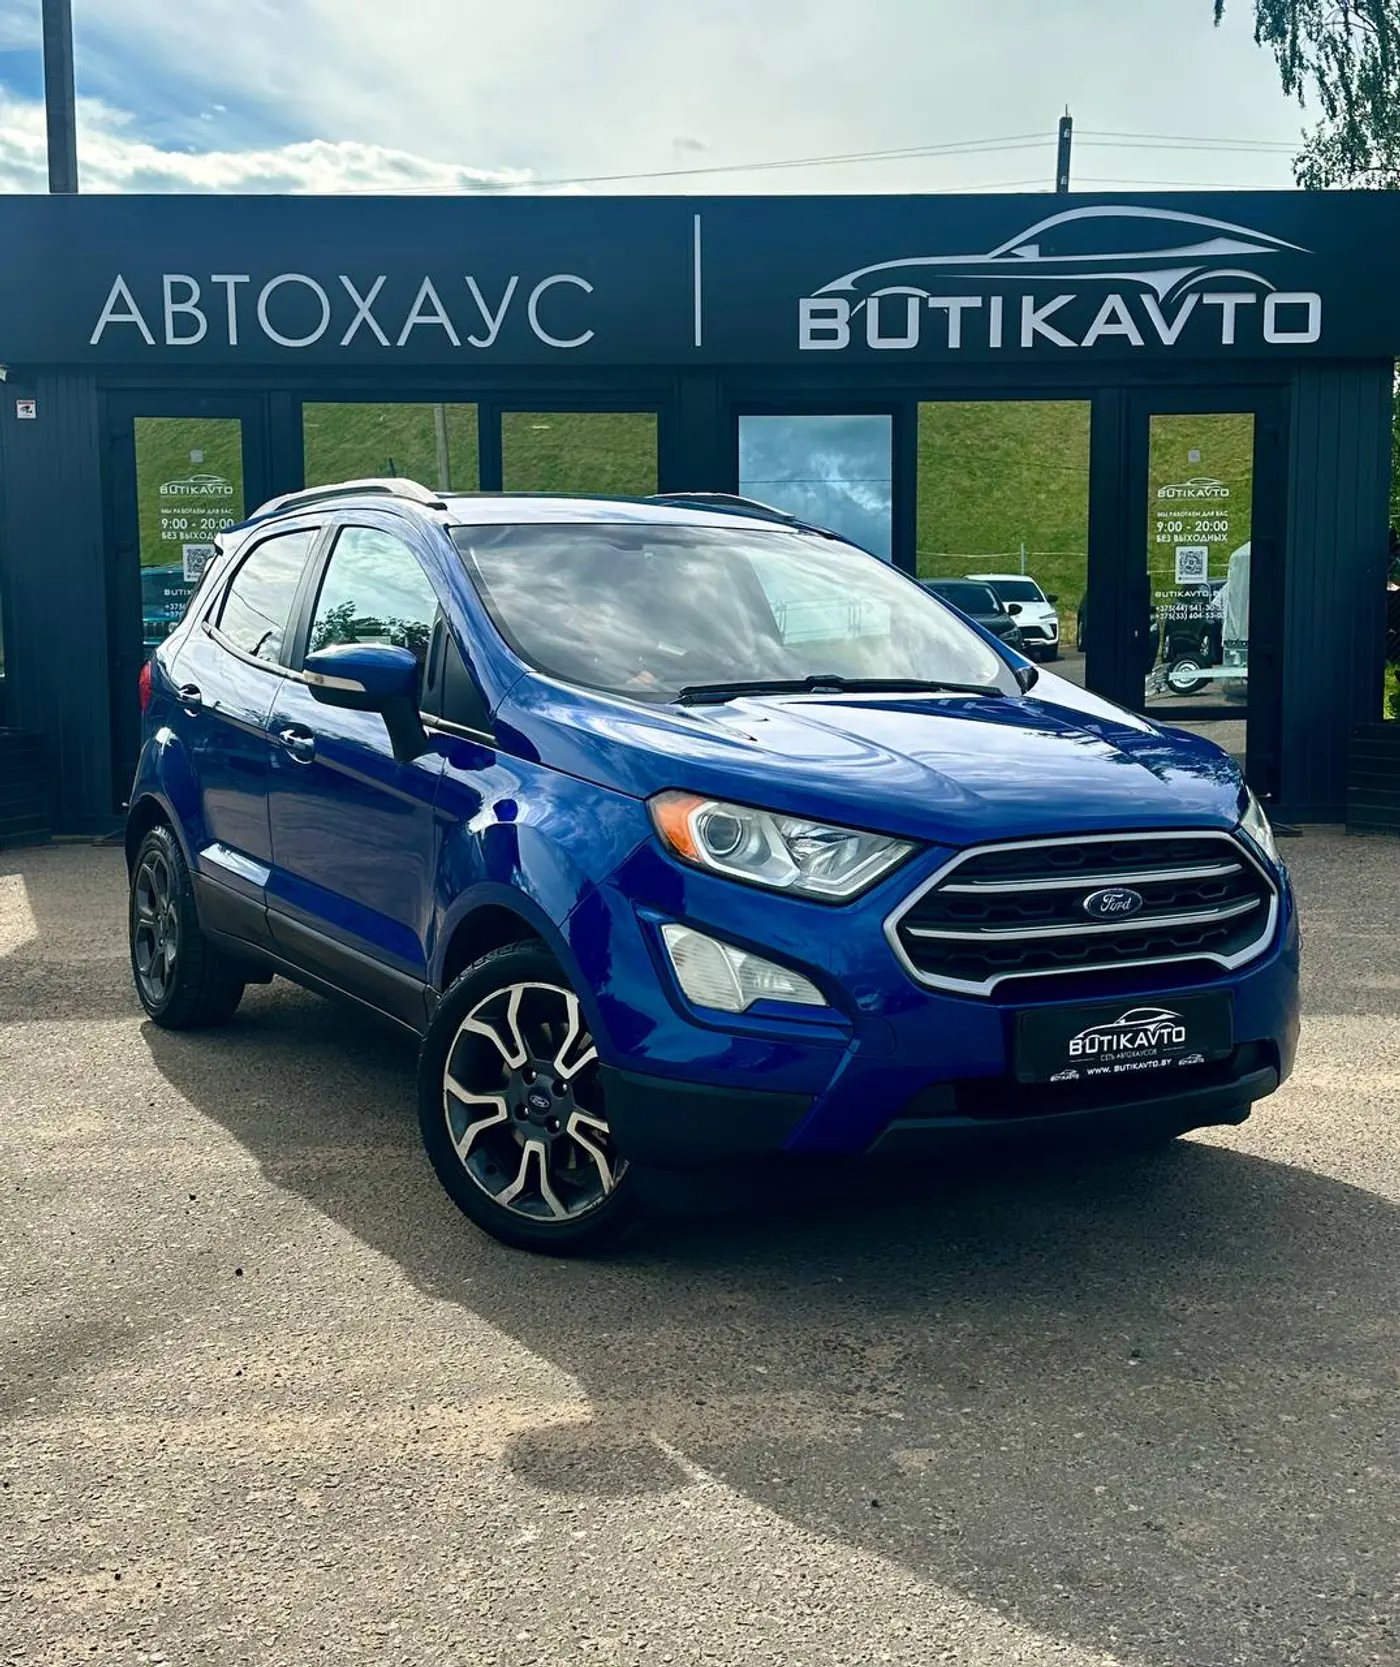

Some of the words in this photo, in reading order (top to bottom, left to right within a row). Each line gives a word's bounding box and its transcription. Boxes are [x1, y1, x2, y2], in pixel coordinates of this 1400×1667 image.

[90, 273, 595, 348] АВТОХАУС
[799, 292, 1322, 350] BUTIKAVTO
[160, 485, 233, 495] BUTIKAVTO
[1157, 488, 1230, 498] BUTIKAVTO
[161, 518, 188, 530] 9:00
[1156, 520, 1183, 532] 9:00
[1195, 520, 1229, 532] 20:00
[1173, 533, 1229, 543] ВЫХОДНЫХ
[1100, 893, 1132, 912] Ford
[1069, 1025, 1186, 1057] BUTIKAVTO
